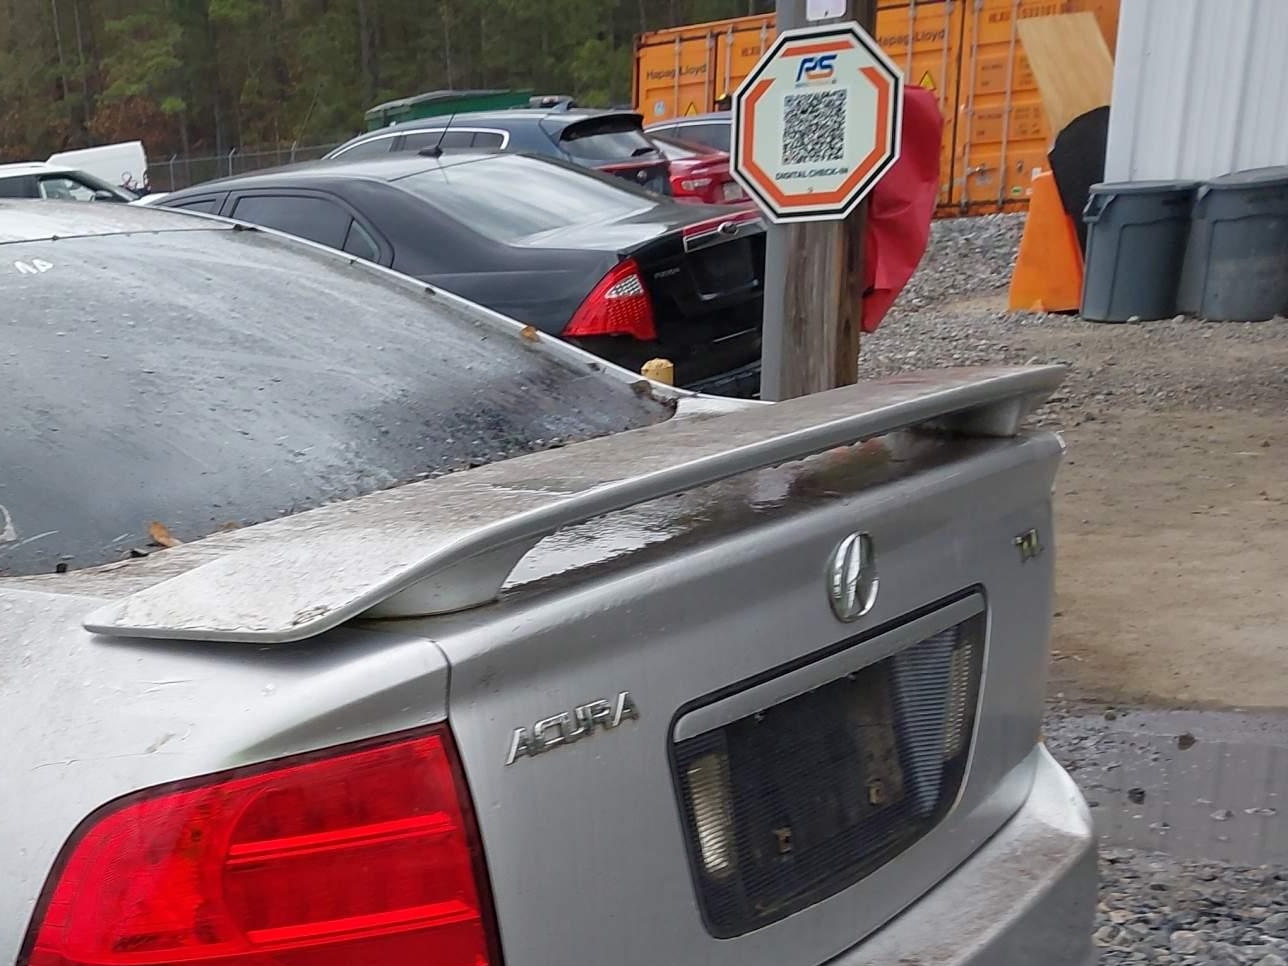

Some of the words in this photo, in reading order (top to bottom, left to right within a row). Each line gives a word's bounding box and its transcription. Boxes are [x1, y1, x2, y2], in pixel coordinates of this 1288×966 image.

[646, 64, 707, 80] HapagLloyd
[775, 170, 808, 181] DIGITAL
[503, 690, 639, 767] ACURA
